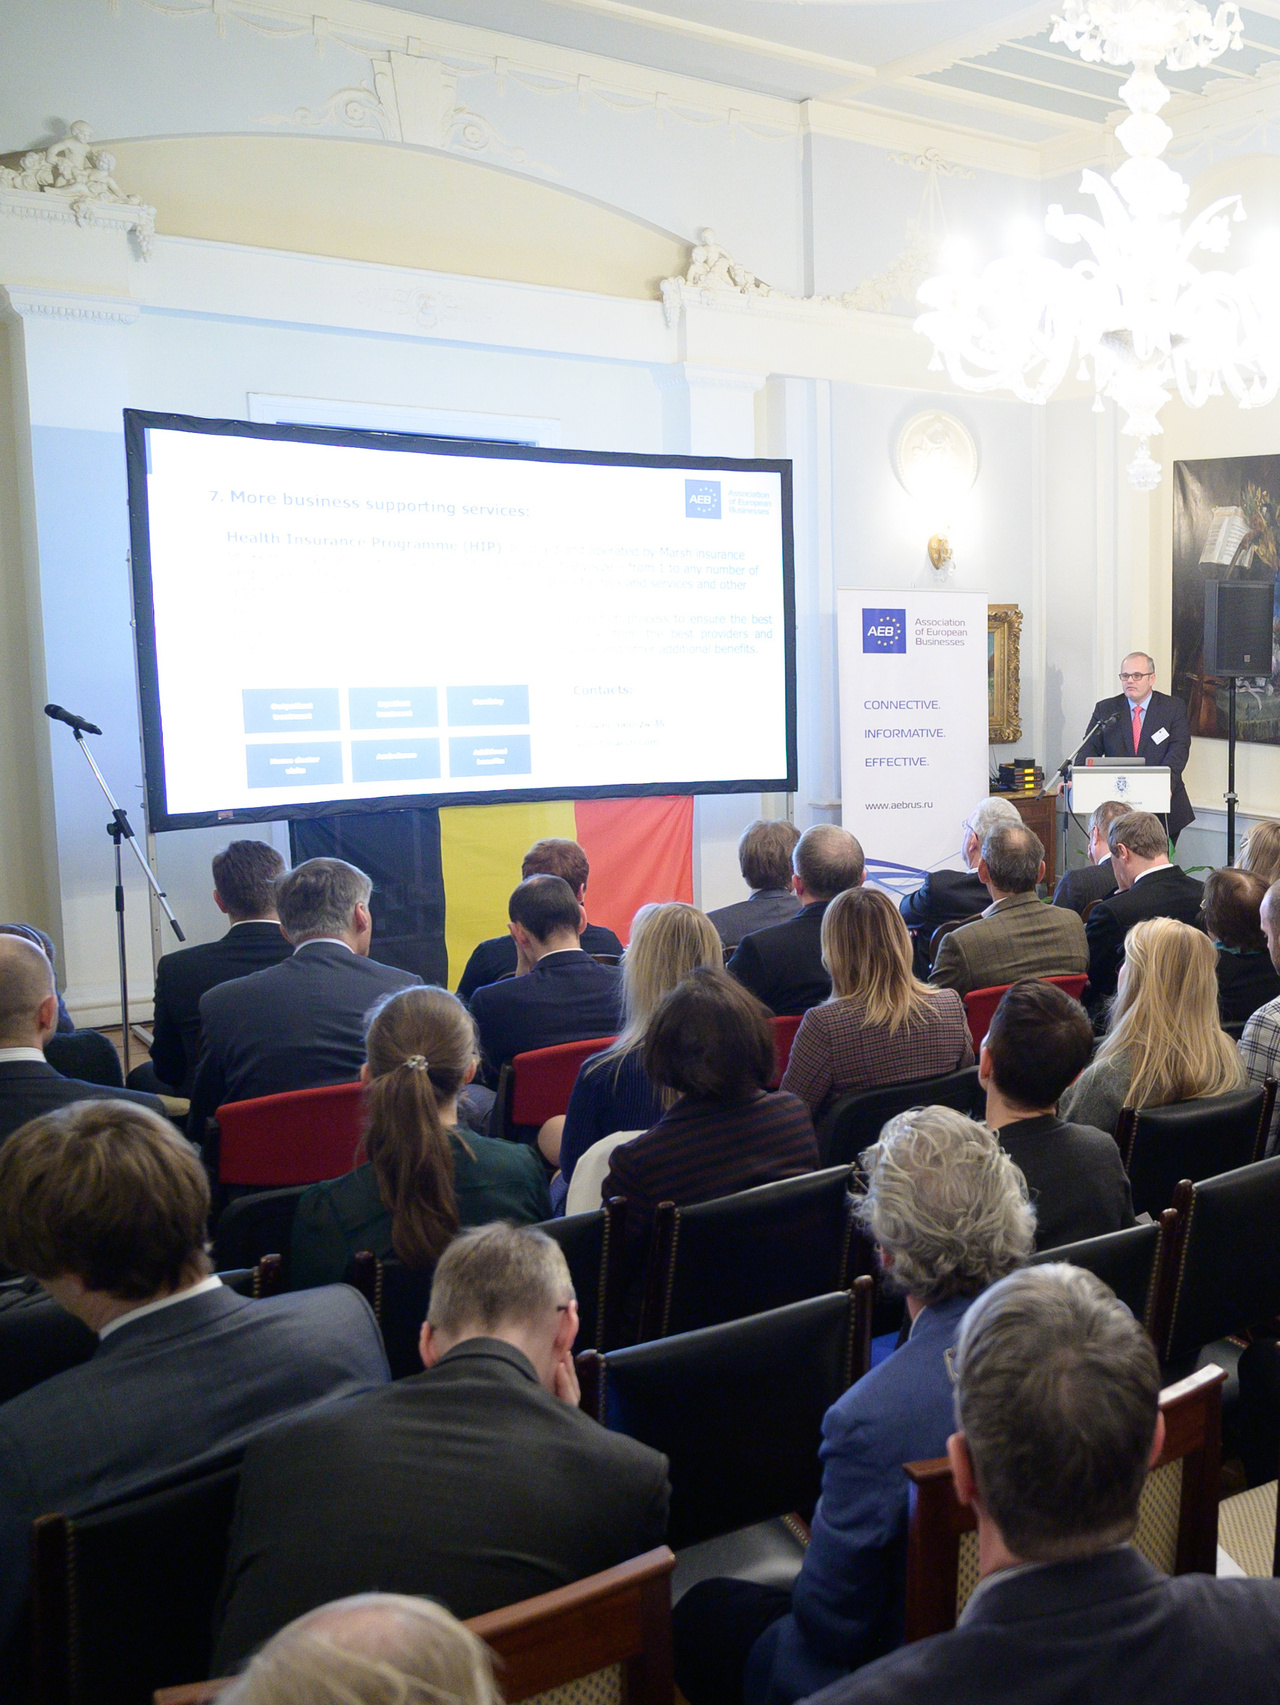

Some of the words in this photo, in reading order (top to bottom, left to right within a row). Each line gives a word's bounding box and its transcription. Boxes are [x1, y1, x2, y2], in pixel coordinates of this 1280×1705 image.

[689, 494, 712, 505] AEB
[728, 490, 771, 499] Association
[208, 489, 224, 503] 7.
[229, 490, 278, 506] More
[282, 492, 361, 510] business
[365, 496, 456, 517] supporting
[461, 503, 531, 518] services:
[226, 530, 281, 545] Health
[286, 533, 366, 547] Insurance
[371, 536, 458, 552] Programme
[462, 540, 502, 555] (HIP)
[660, 547, 692, 558] Marsh
[696, 548, 745, 560] insurance
[706, 565, 746, 576] number
[749, 565, 760, 576] of
[697, 579, 717, 590] and
[719, 579, 747, 590] other
[690, 616, 727, 625] ensure
[730, 613, 747, 625] the
[752, 614, 773, 625] best
[915, 618, 965, 627] Association
[700, 629, 749, 642] providers
[754, 629, 773, 639] and
[867, 626, 894, 637] AEB
[915, 628, 924, 636] of
[926, 628, 967, 638] European
[915, 637, 965, 647] Businesses
[714, 643, 759, 655] benefits.
[573, 685, 633, 696] Contacts:
[863, 700, 941, 710] CONNECTIVE.
[864, 728, 946, 739] INFORMATIVE.
[865, 757, 929, 767] EFFECTIVE.
[865, 801, 934, 811] www.aebrus.ru
